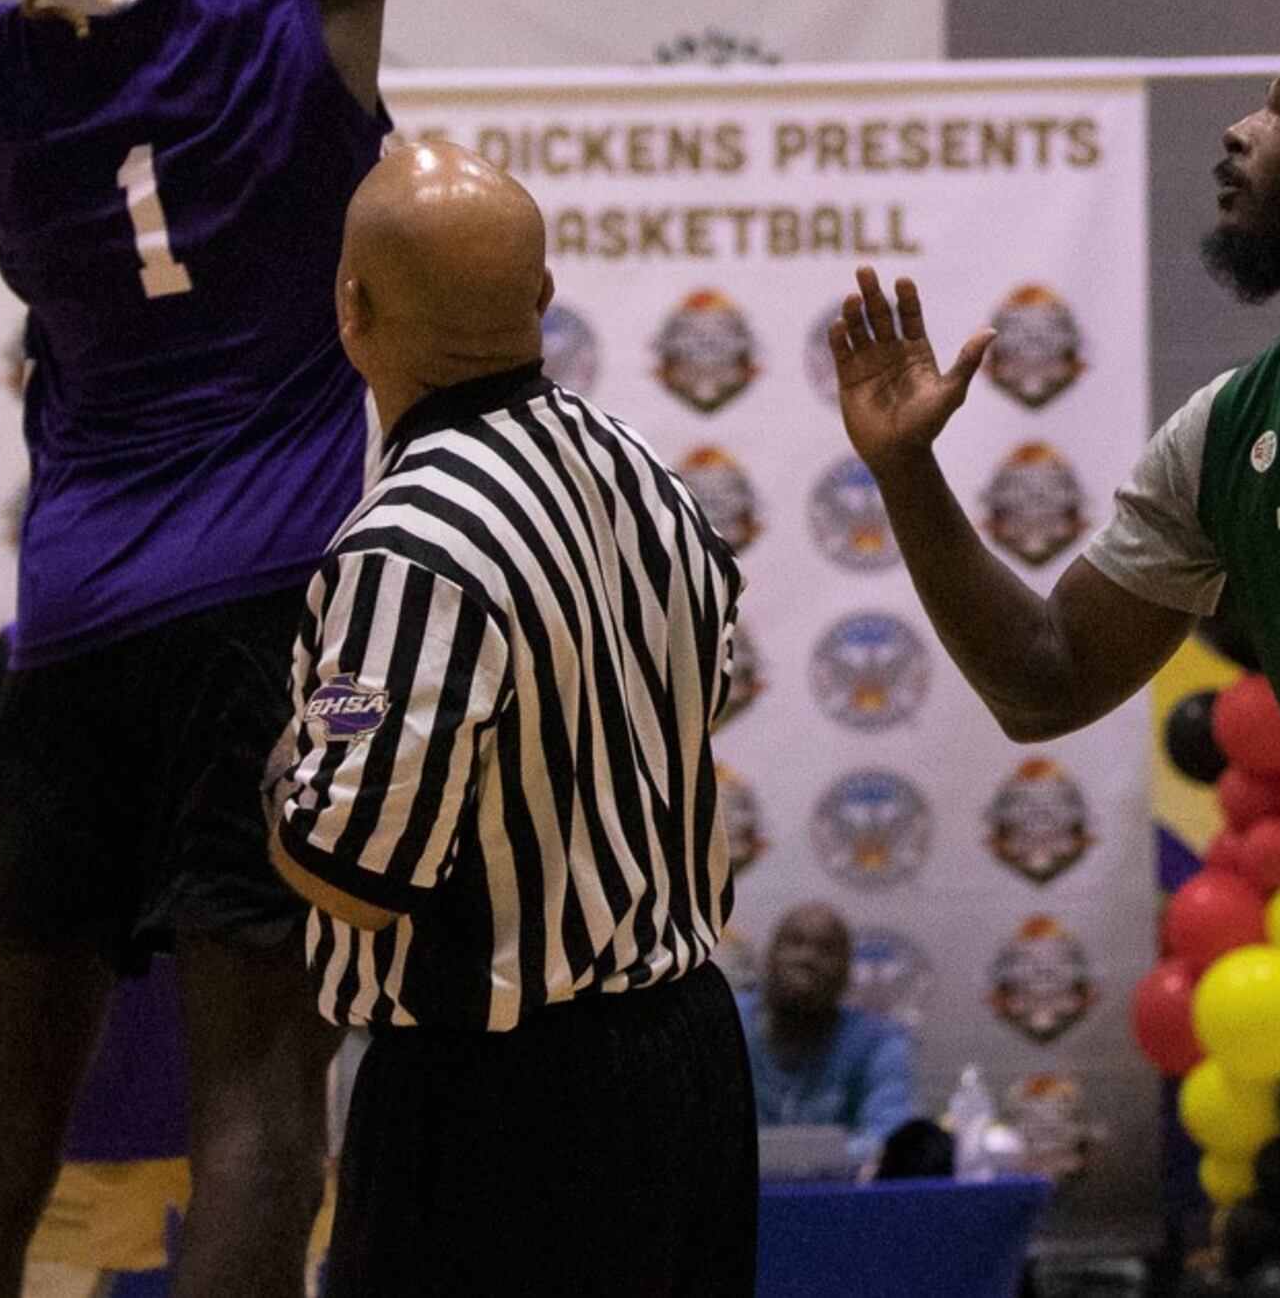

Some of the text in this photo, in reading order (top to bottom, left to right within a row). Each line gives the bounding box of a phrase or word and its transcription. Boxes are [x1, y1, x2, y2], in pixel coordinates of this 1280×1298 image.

[477, 115, 1102, 177] DICKENS PRESENTS
[116, 143, 192, 299] 1
[553, 203, 923, 259] ASKETBALL
[306, 695, 386, 715] GHSA
